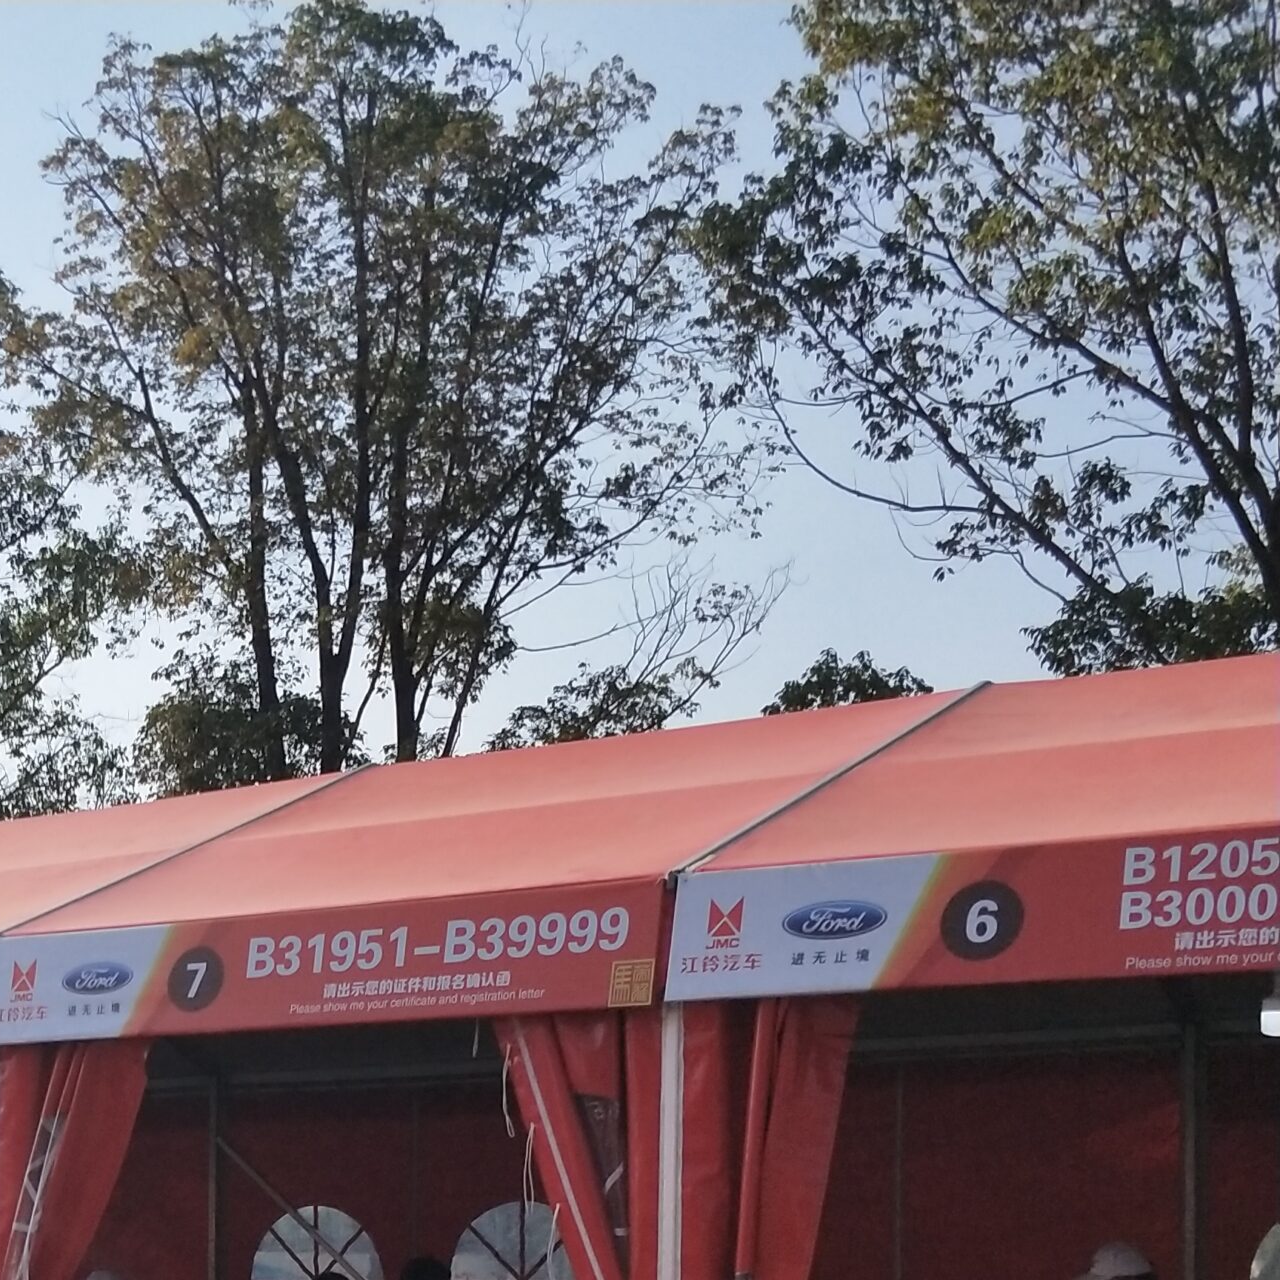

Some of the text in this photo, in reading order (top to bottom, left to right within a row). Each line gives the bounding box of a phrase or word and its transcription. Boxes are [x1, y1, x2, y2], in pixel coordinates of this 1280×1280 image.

[1123, 837, 1280, 886] B1205
[1119, 883, 1278, 930] B3000
[802, 907, 866, 934] Ford
[965, 899, 999, 943] 6
[246, 906, 630, 979] B31951-B39999
[705, 938, 739, 950] JMC
[1174, 926, 1280, 950] 请出示您的
[680, 953, 763, 974] 江铃汽车
[790, 948, 870, 966] 进无止境
[1125, 951, 1273, 969] Please show me your
[76, 969, 120, 990] Ford
[186, 962, 207, 998] 7
[323, 970, 511, 998] 请出示您的证件和报名确认函
[10, 993, 33, 1003] JMC
[289, 987, 545, 1014] Please show me your certificate and registration letter
